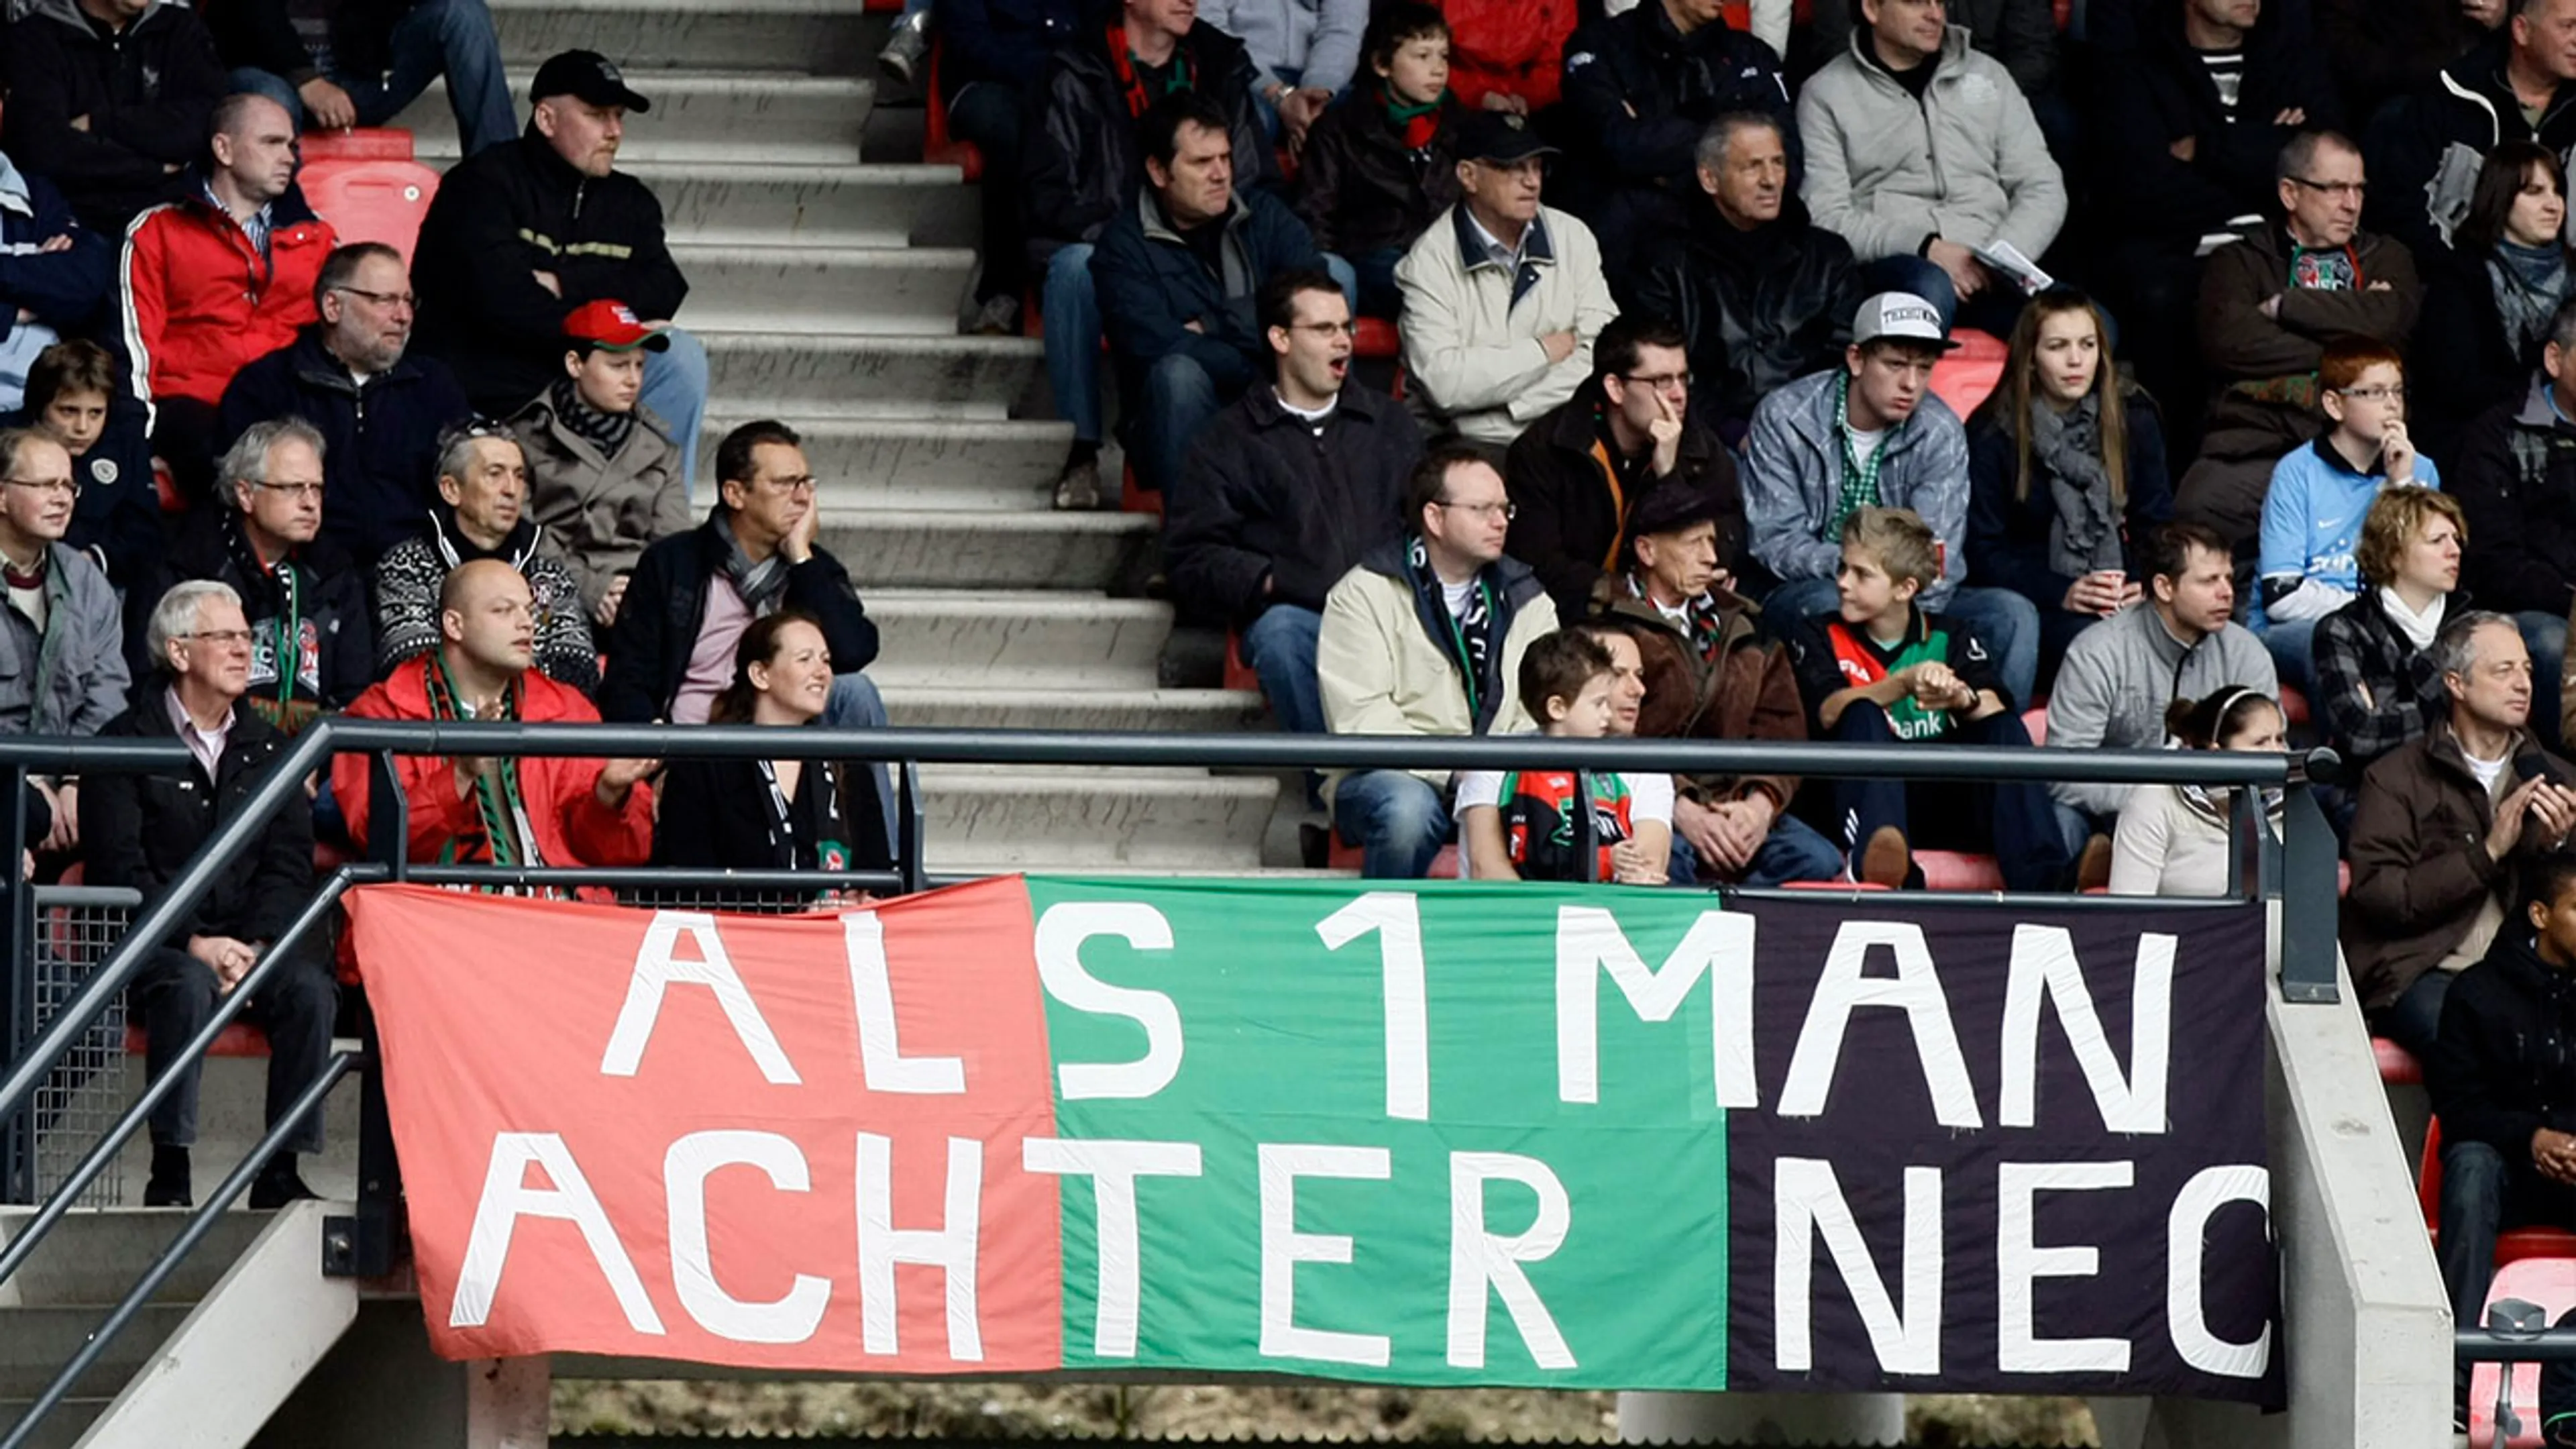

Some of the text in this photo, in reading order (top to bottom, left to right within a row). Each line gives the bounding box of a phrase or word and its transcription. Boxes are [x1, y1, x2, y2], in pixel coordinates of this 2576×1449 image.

[600, 891, 2178, 1134] ALS 1 MAN
[449, 1124, 2271, 1378] ACHTER NEC
